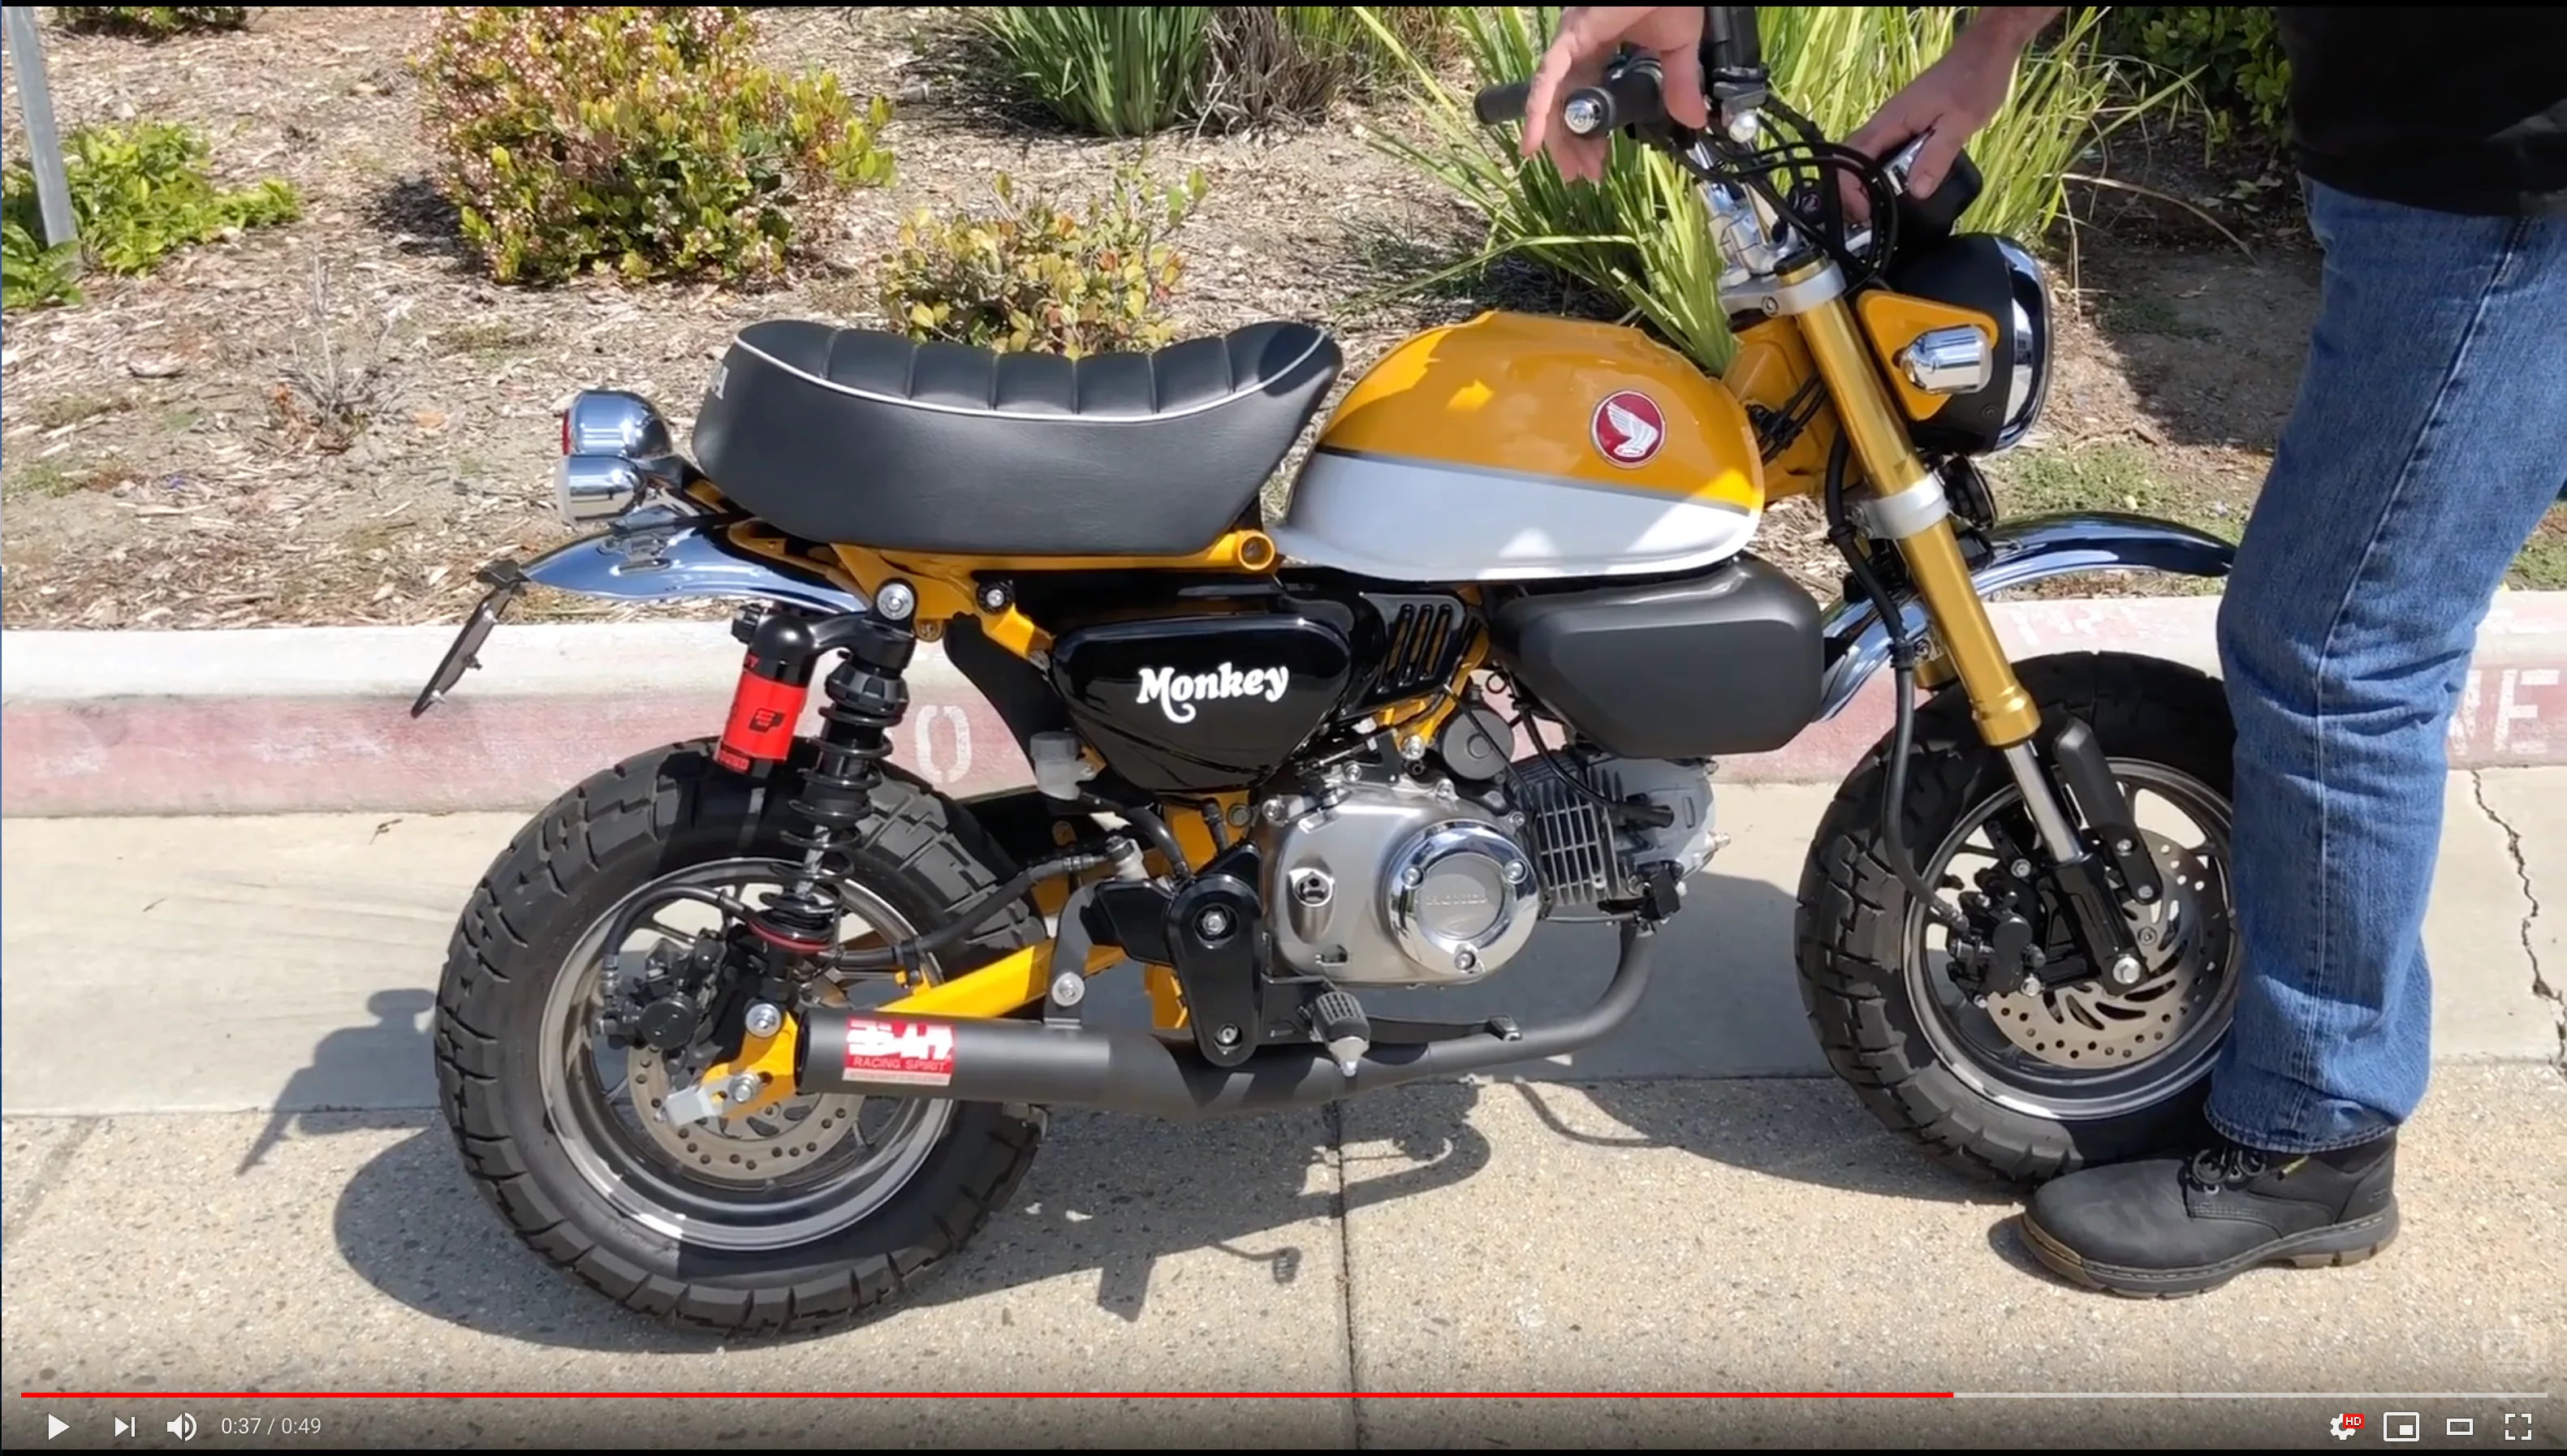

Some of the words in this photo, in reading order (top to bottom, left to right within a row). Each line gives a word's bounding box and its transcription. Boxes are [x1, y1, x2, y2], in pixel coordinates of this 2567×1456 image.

[1137, 661, 1289, 723] Monkey
[852, 1056, 901, 1069] RACING
[905, 1059, 947, 1071] SPIRIT
